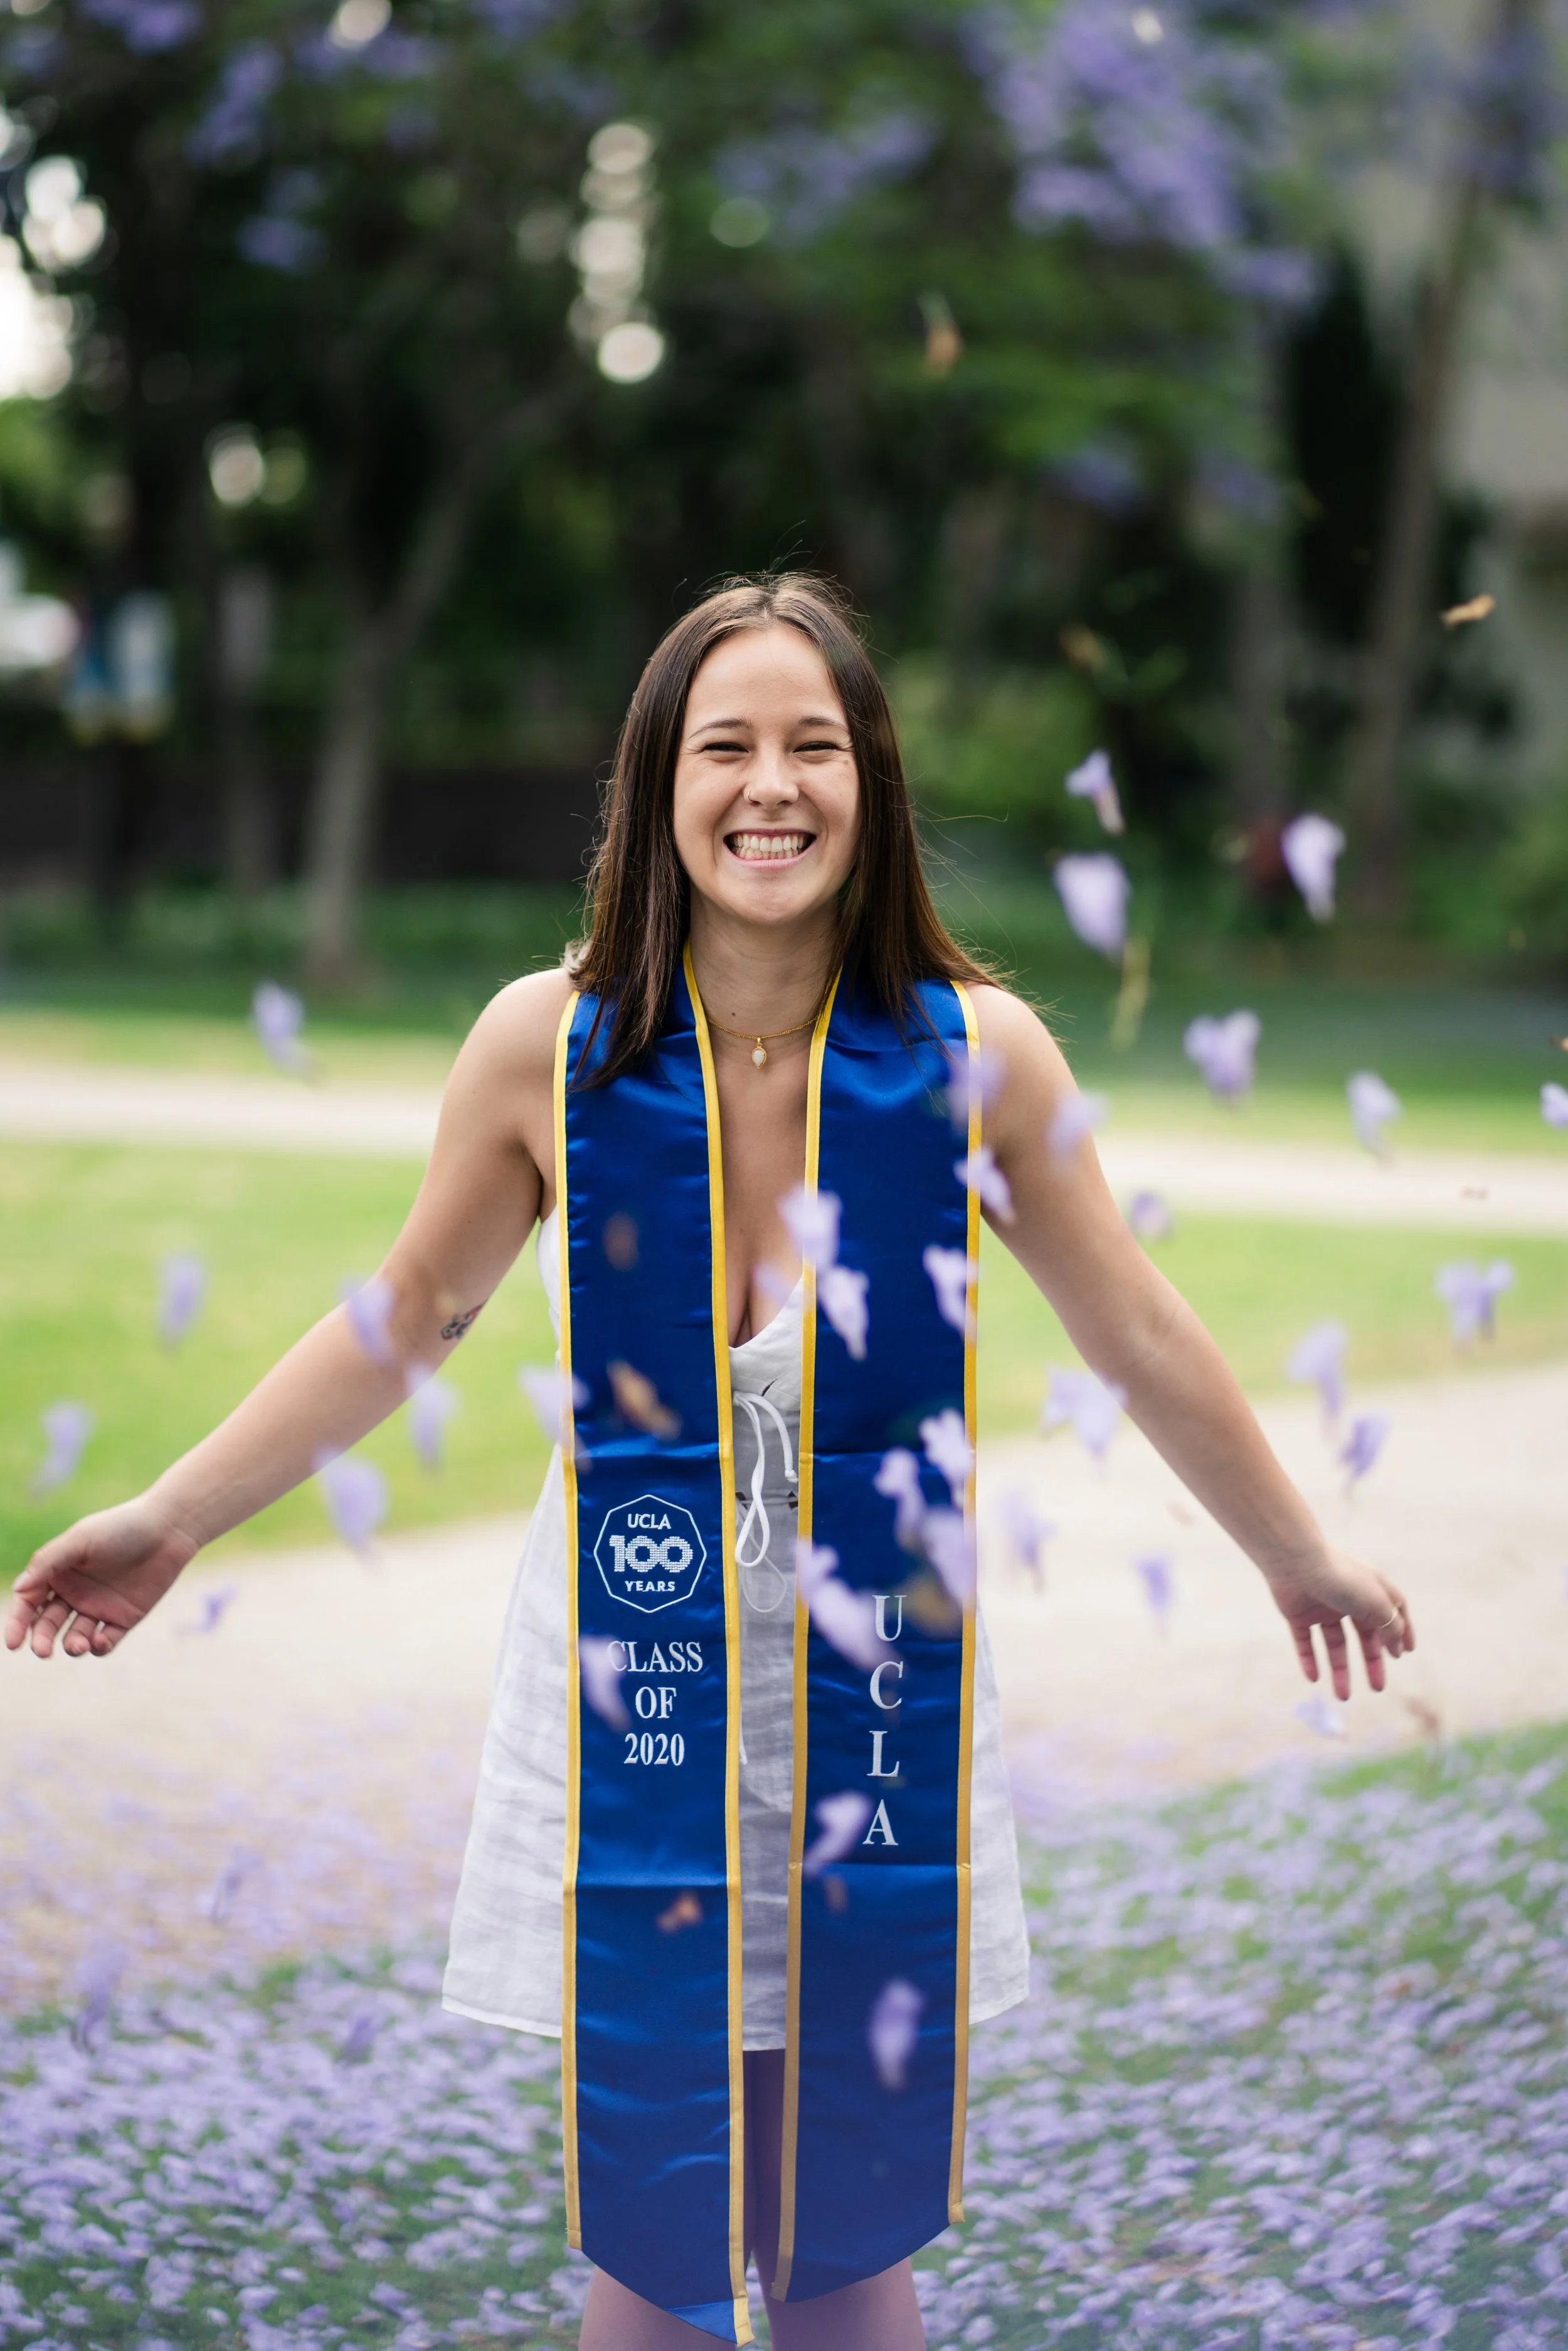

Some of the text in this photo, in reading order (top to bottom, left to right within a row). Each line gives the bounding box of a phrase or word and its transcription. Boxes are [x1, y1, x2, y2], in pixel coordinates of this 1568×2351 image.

[627, 1514, 672, 1530] UCLA
[609, 1535, 694, 1573] 100
[625, 1581, 676, 1593] YEARS
[606, 1640, 704, 1673] CLASS
[635, 1686, 677, 1719] OF
[862, 1595, 907, 1846] UCLA
[624, 1733, 686, 1766] 2020
